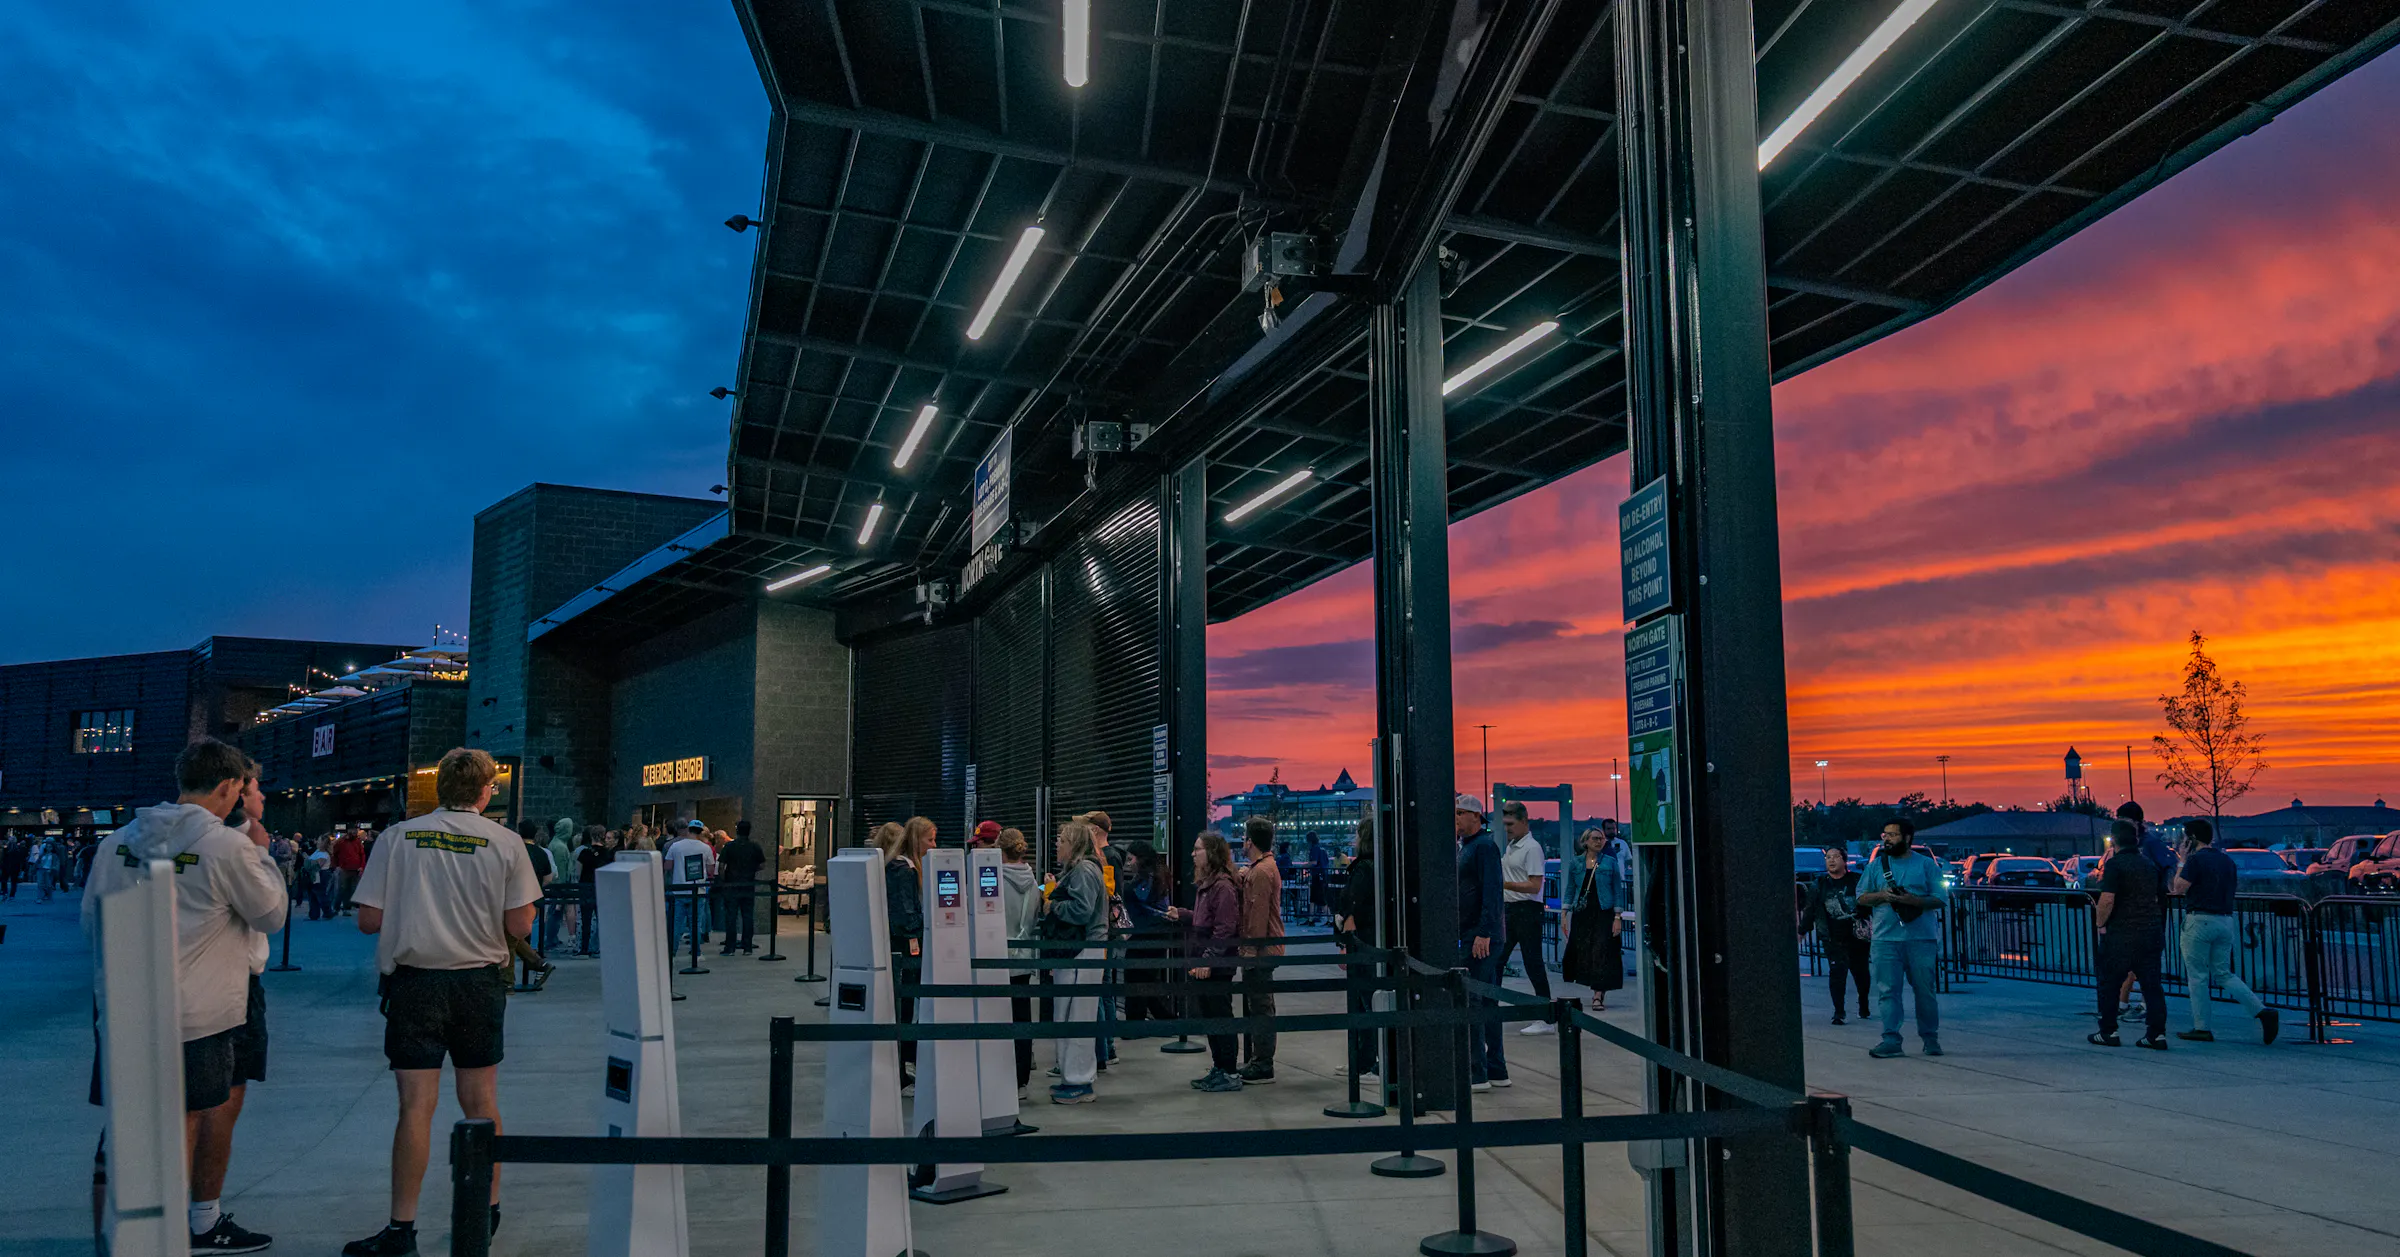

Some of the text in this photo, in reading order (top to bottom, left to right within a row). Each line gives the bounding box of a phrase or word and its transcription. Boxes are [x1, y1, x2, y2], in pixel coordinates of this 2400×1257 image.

[1622, 494, 1662, 532] NO RE-ENTRY
[1624, 531, 1663, 566] NO ALCOHOL
[961, 549, 984, 595] NORTH
[1632, 557, 1657, 583] BEYOND
[1628, 576, 1662, 607] THIS POINT
[1627, 625, 1665, 653] NORTH GATE
[314, 727, 334, 754] BAR
[644, 759, 702, 785] MERCH SHOP
[406, 831, 435, 839] MUSIC
[443, 832, 487, 846] MEMORIES
